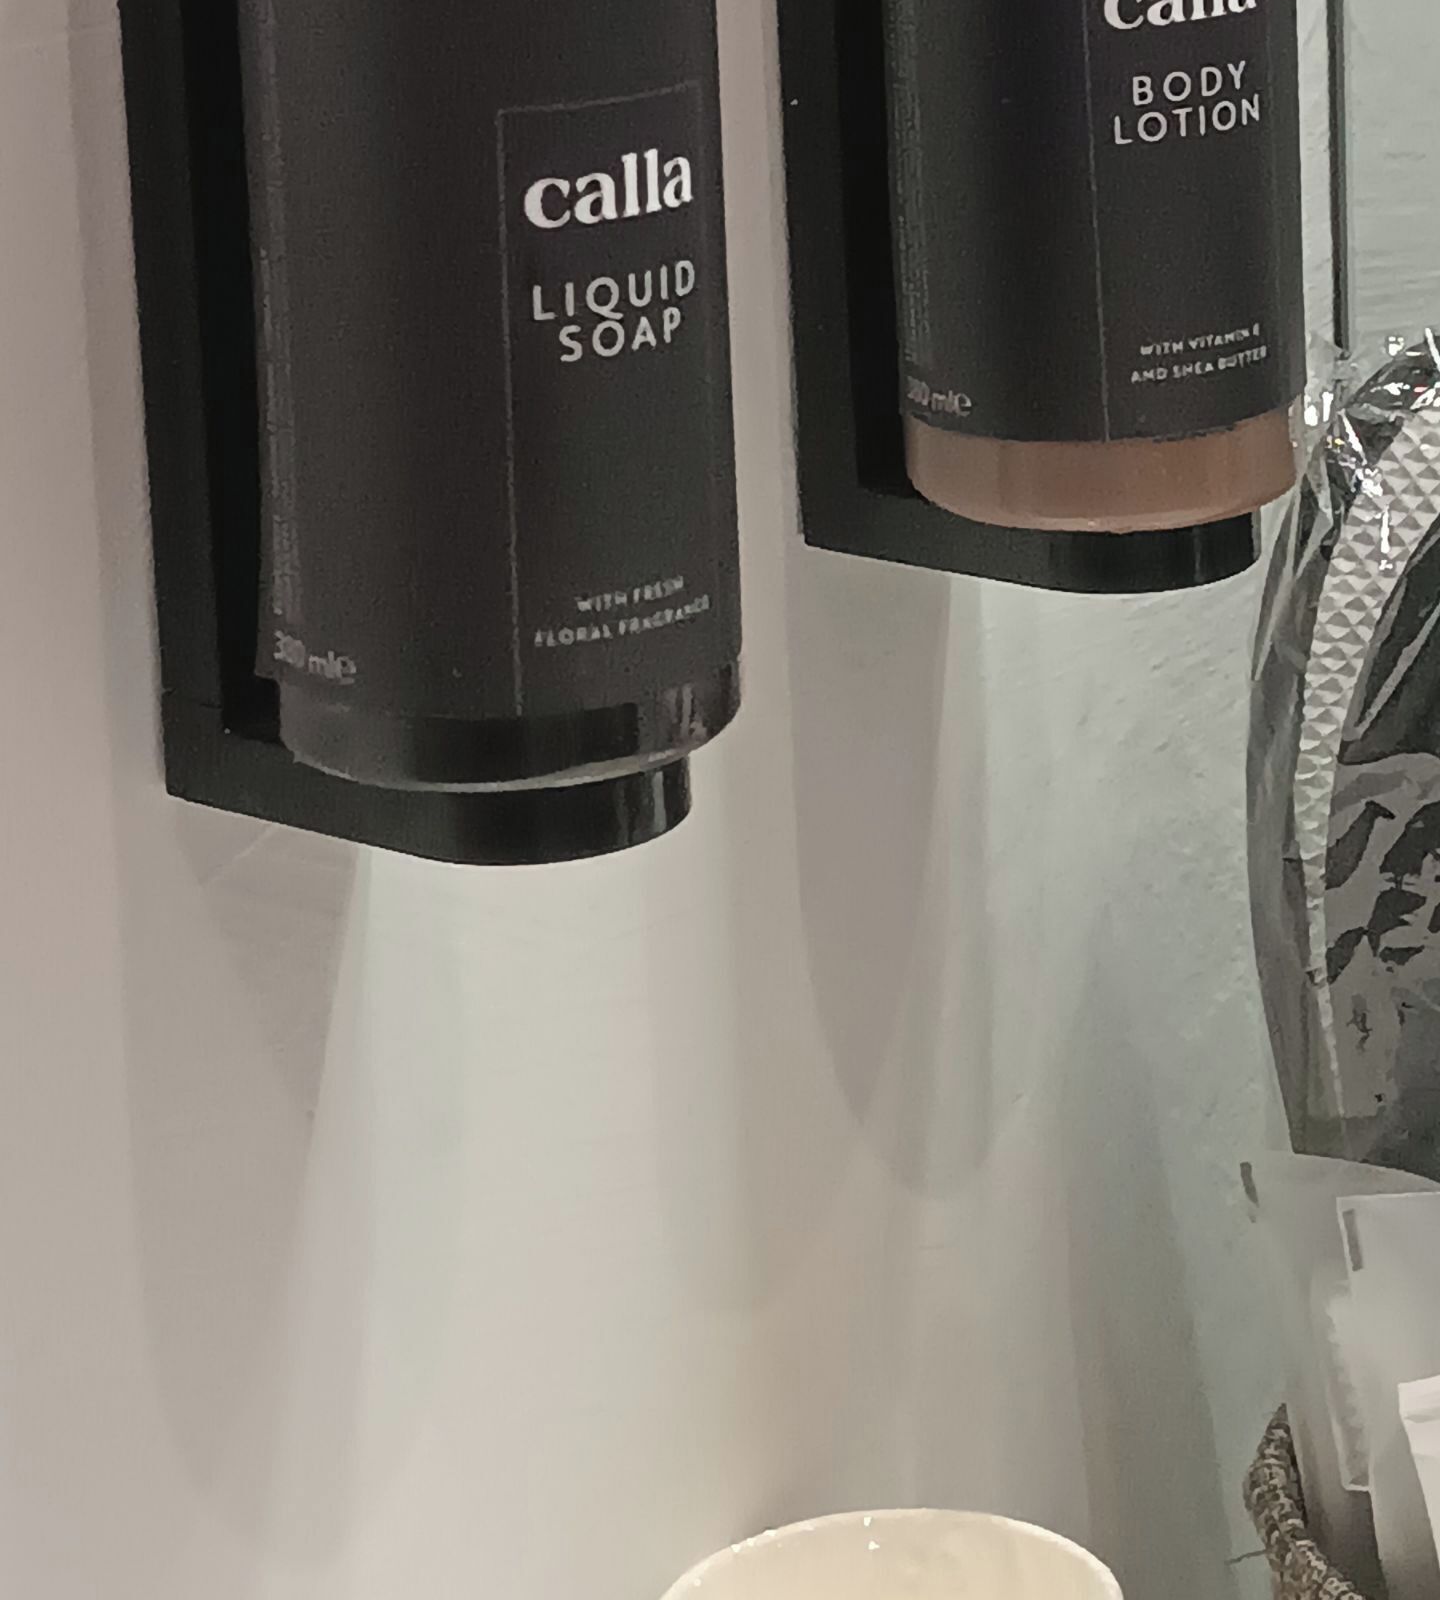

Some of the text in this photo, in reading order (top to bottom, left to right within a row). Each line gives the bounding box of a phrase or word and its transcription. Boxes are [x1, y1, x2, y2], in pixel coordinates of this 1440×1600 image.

[1132, 60, 1247, 106] BODY
[1114, 94, 1261, 145] LOTION
[524, 148, 694, 229] calla
[532, 259, 696, 322] LIQUID
[559, 307, 682, 362] SOAP
[1140, 342, 1184, 356] WITH
[1130, 367, 1168, 384] AND
